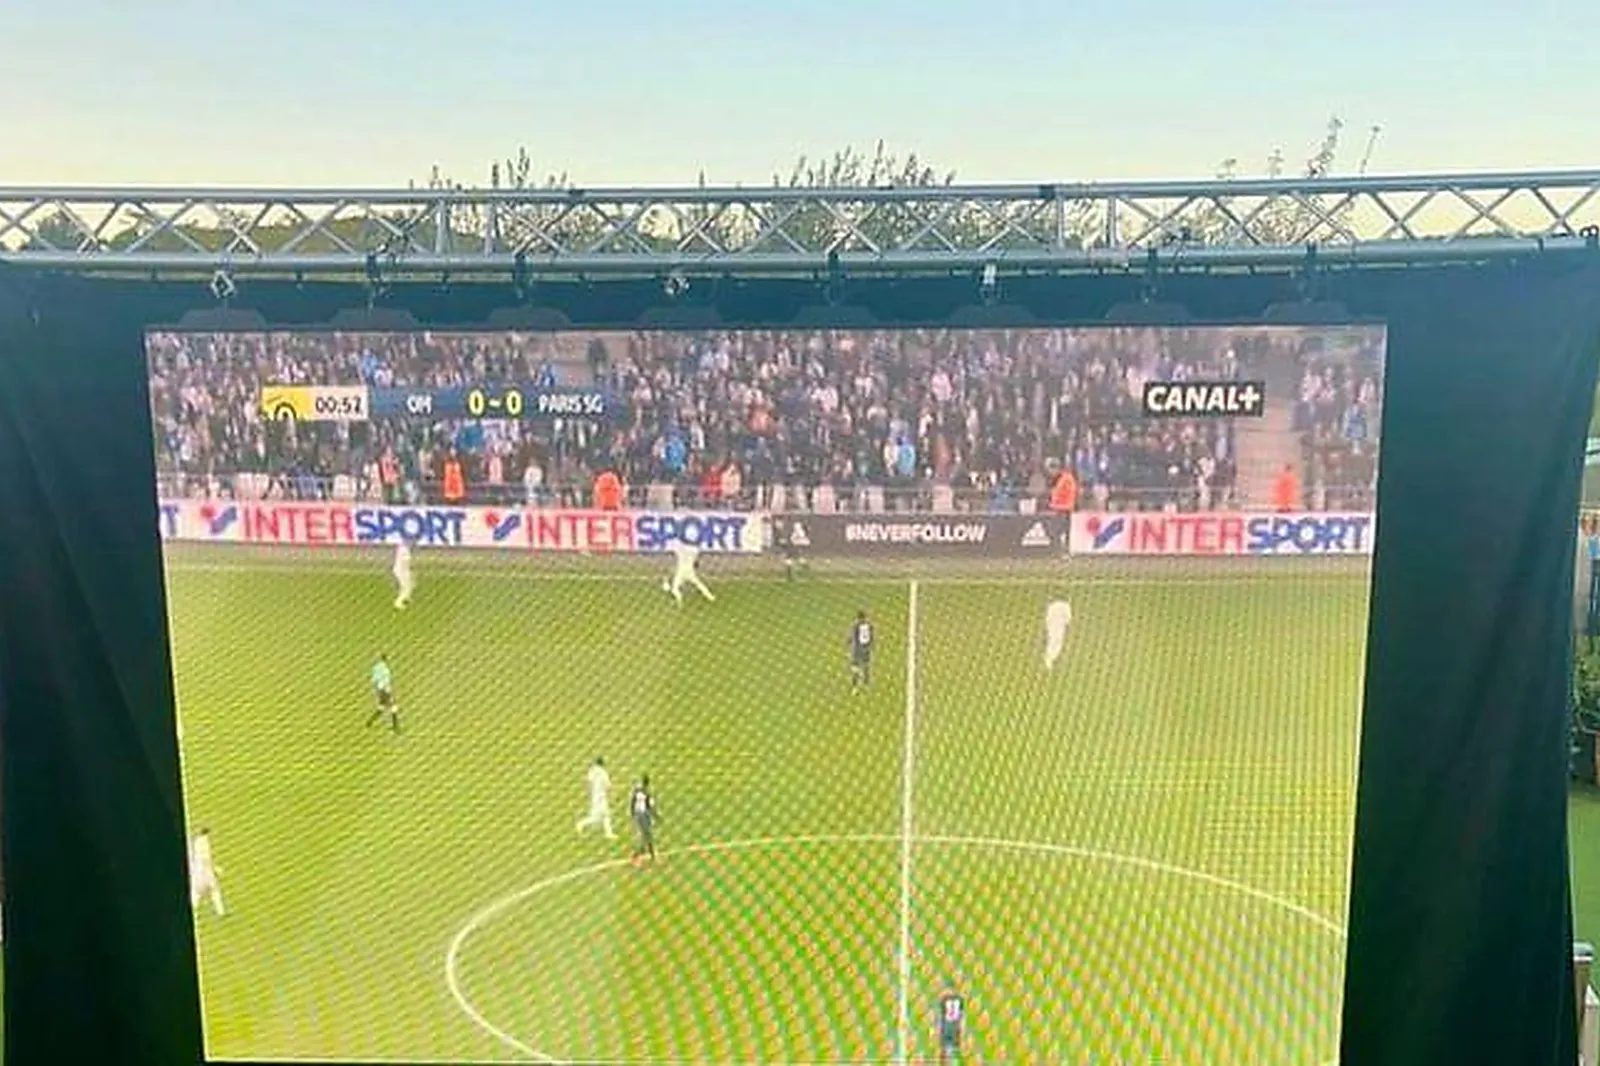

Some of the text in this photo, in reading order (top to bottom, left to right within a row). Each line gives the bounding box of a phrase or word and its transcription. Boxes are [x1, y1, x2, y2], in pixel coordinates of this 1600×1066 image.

[1147, 385, 1260, 412] CANAL+
[243, 505, 467, 544] INTERSPORT
[526, 511, 746, 549] INTERSPORT
[1128, 512, 1370, 553] INTERSPORT
